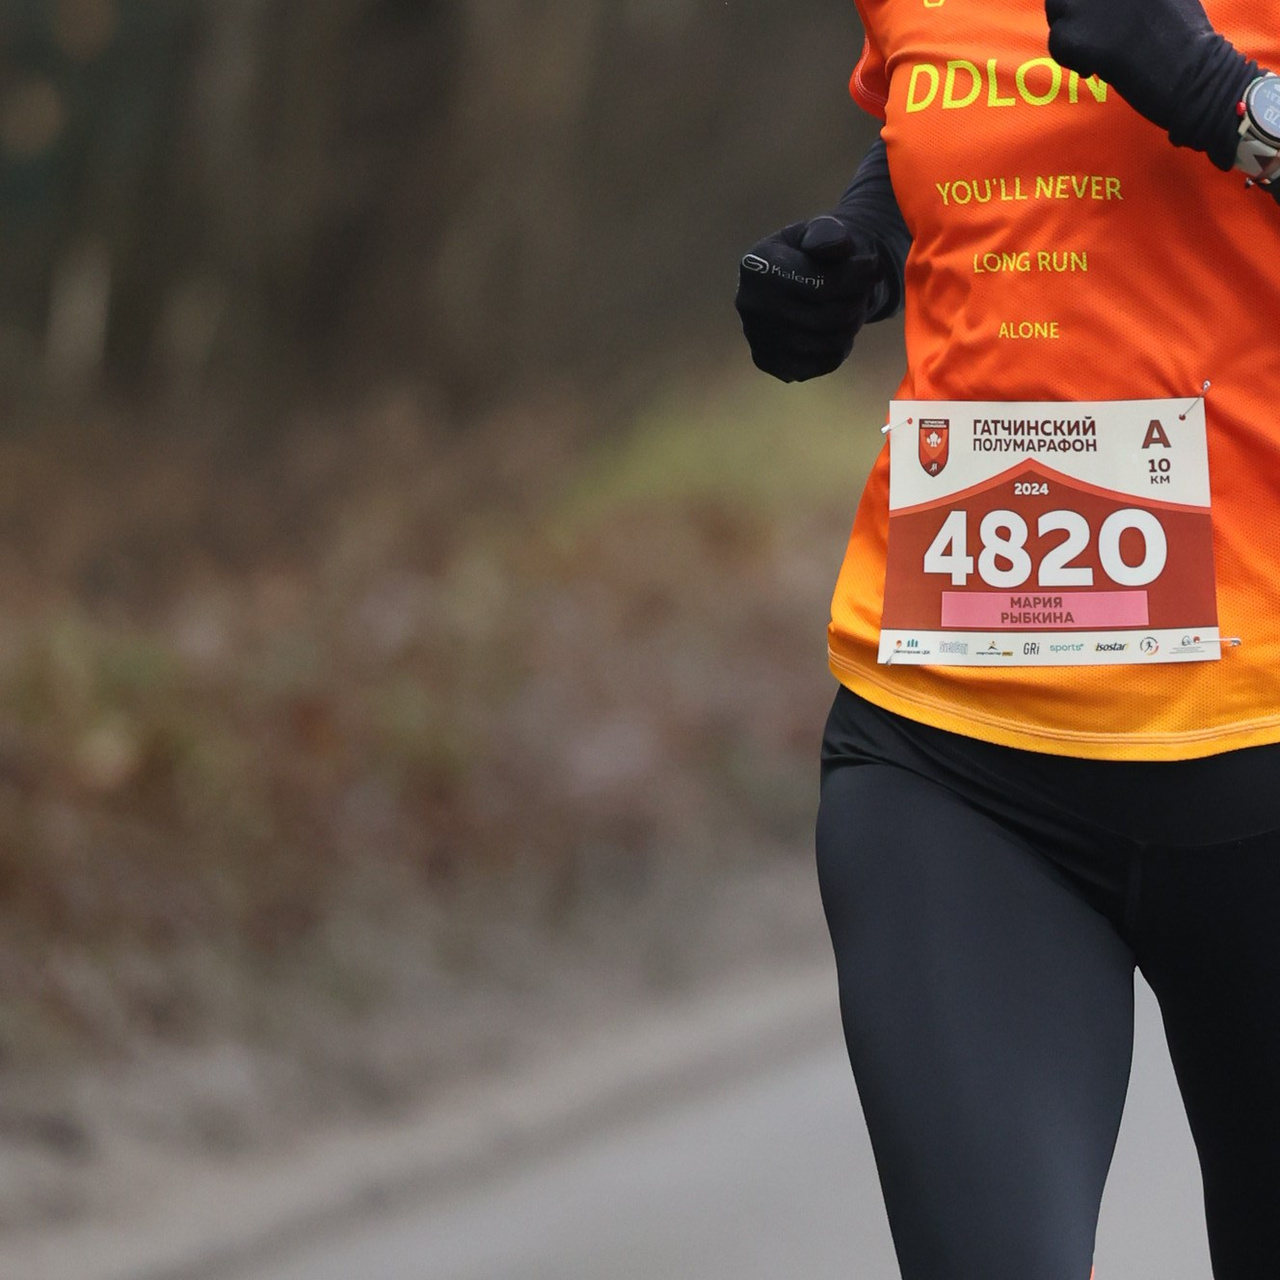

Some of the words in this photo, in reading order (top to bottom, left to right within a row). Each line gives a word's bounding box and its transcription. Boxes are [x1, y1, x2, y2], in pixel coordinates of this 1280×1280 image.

[935, 177, 1028, 206] YOU'LL
[1034, 175, 1123, 200] NEVER
[972, 251, 1031, 274] LONG
[1036, 250, 1088, 272] RUN
[771, 264, 825, 290] Kalenji
[998, 321, 1060, 339] ALONE
[972, 416, 1096, 437] ГАТЧИНСКИЙ
[972, 437, 1098, 453] ПОЛУМАРАФОН
[1148, 458, 1172, 473] 10
[1150, 475, 1171, 485] КМ
[1013, 482, 1049, 496] 2024
[923, 508, 1168, 588] 4820
[1009, 596, 1063, 609] МАРИЯ
[1000, 612, 1075, 625] РЫБКИНА
